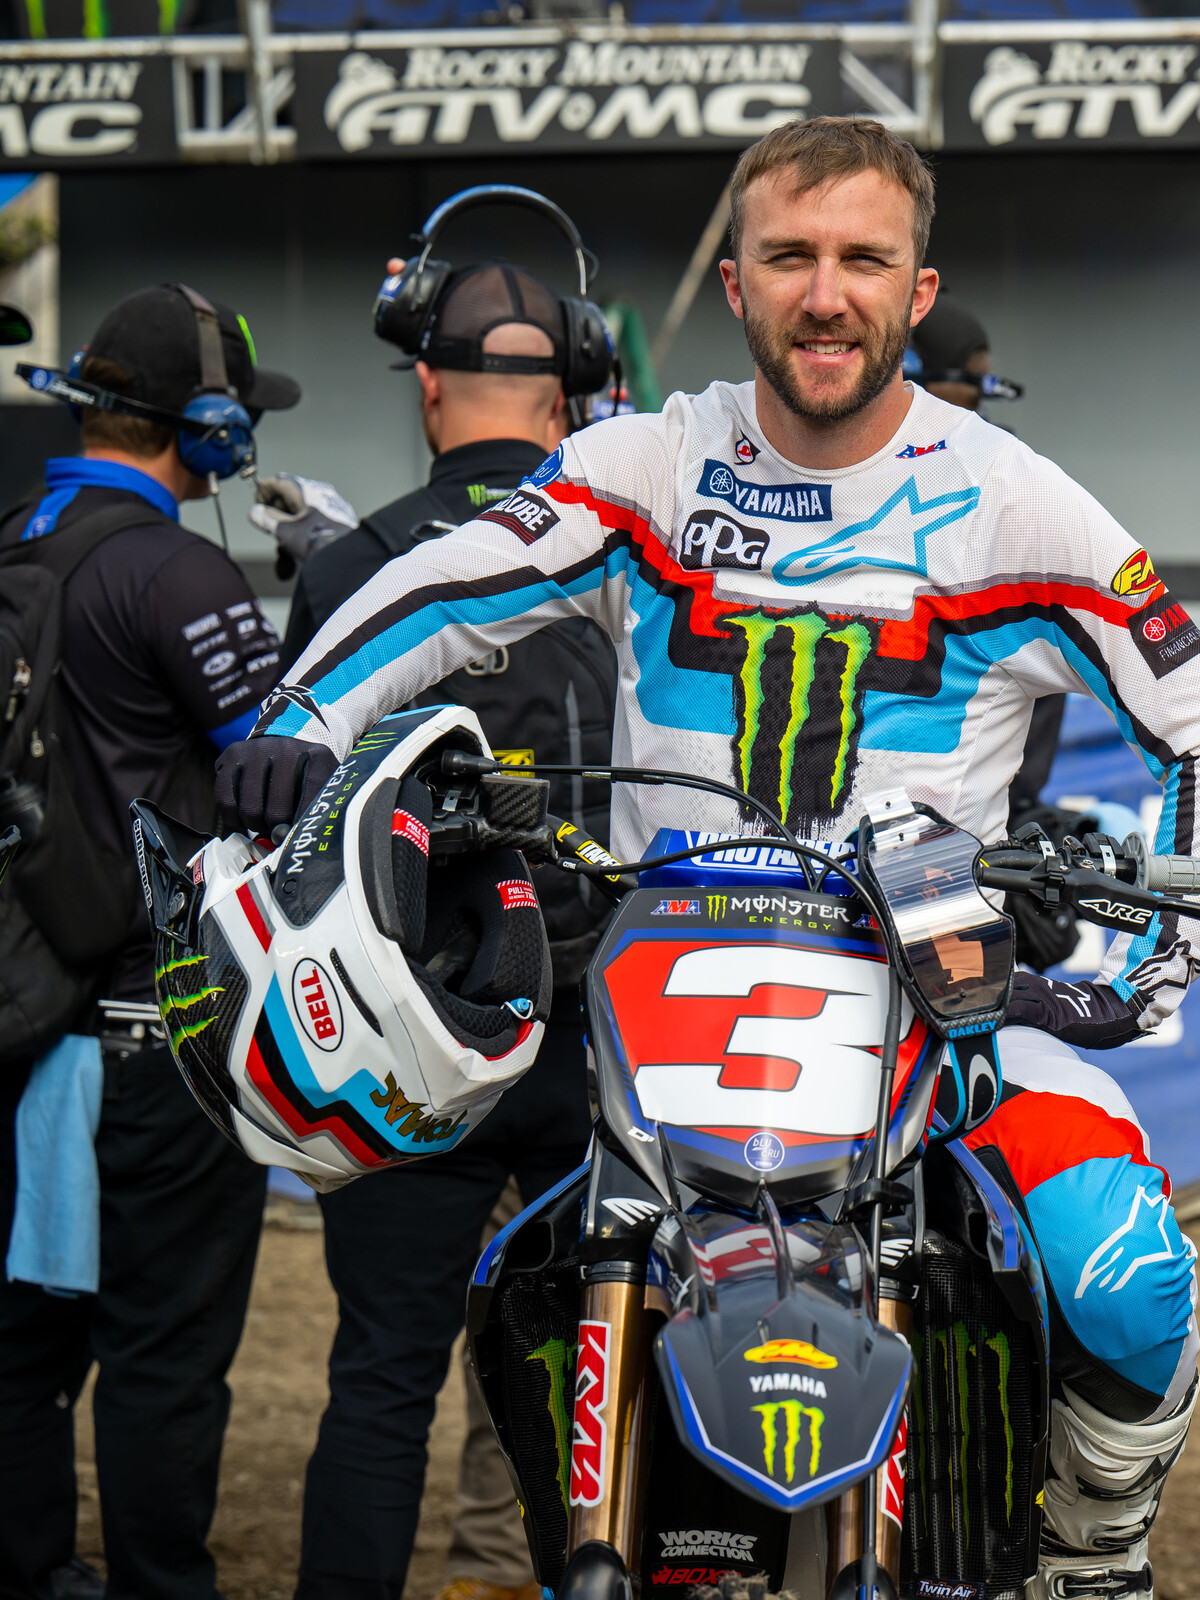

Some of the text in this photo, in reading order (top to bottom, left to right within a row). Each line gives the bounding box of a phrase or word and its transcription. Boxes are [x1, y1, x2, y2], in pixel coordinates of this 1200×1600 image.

[400, 42, 811, 89] ROCKY MOUNTAIN
[1045, 41, 1198, 86] ROCKY
[733, 485, 824, 518] YAMAHA
[684, 515, 766, 567] PPG
[286, 759, 356, 876] MONSTER
[317, 770, 359, 852] ENERGY
[508, 887, 524, 896] PULL
[650, 900, 701, 915] AMA
[731, 895, 850, 922] MONSTER
[1078, 898, 1154, 926] ARC
[749, 915, 832, 930] ENERGY
[301, 968, 338, 1040] BELL
[634, 945, 914, 1137] 3
[948, 1020, 998, 1040] OAKLEY
[749, 1373, 828, 1399] YAMAHA
[658, 1529, 759, 1550] WORKS
[660, 1545, 755, 1562] CONNECTION
[919, 1579, 951, 1596] Twin
[950, 1585, 975, 1598] Air
